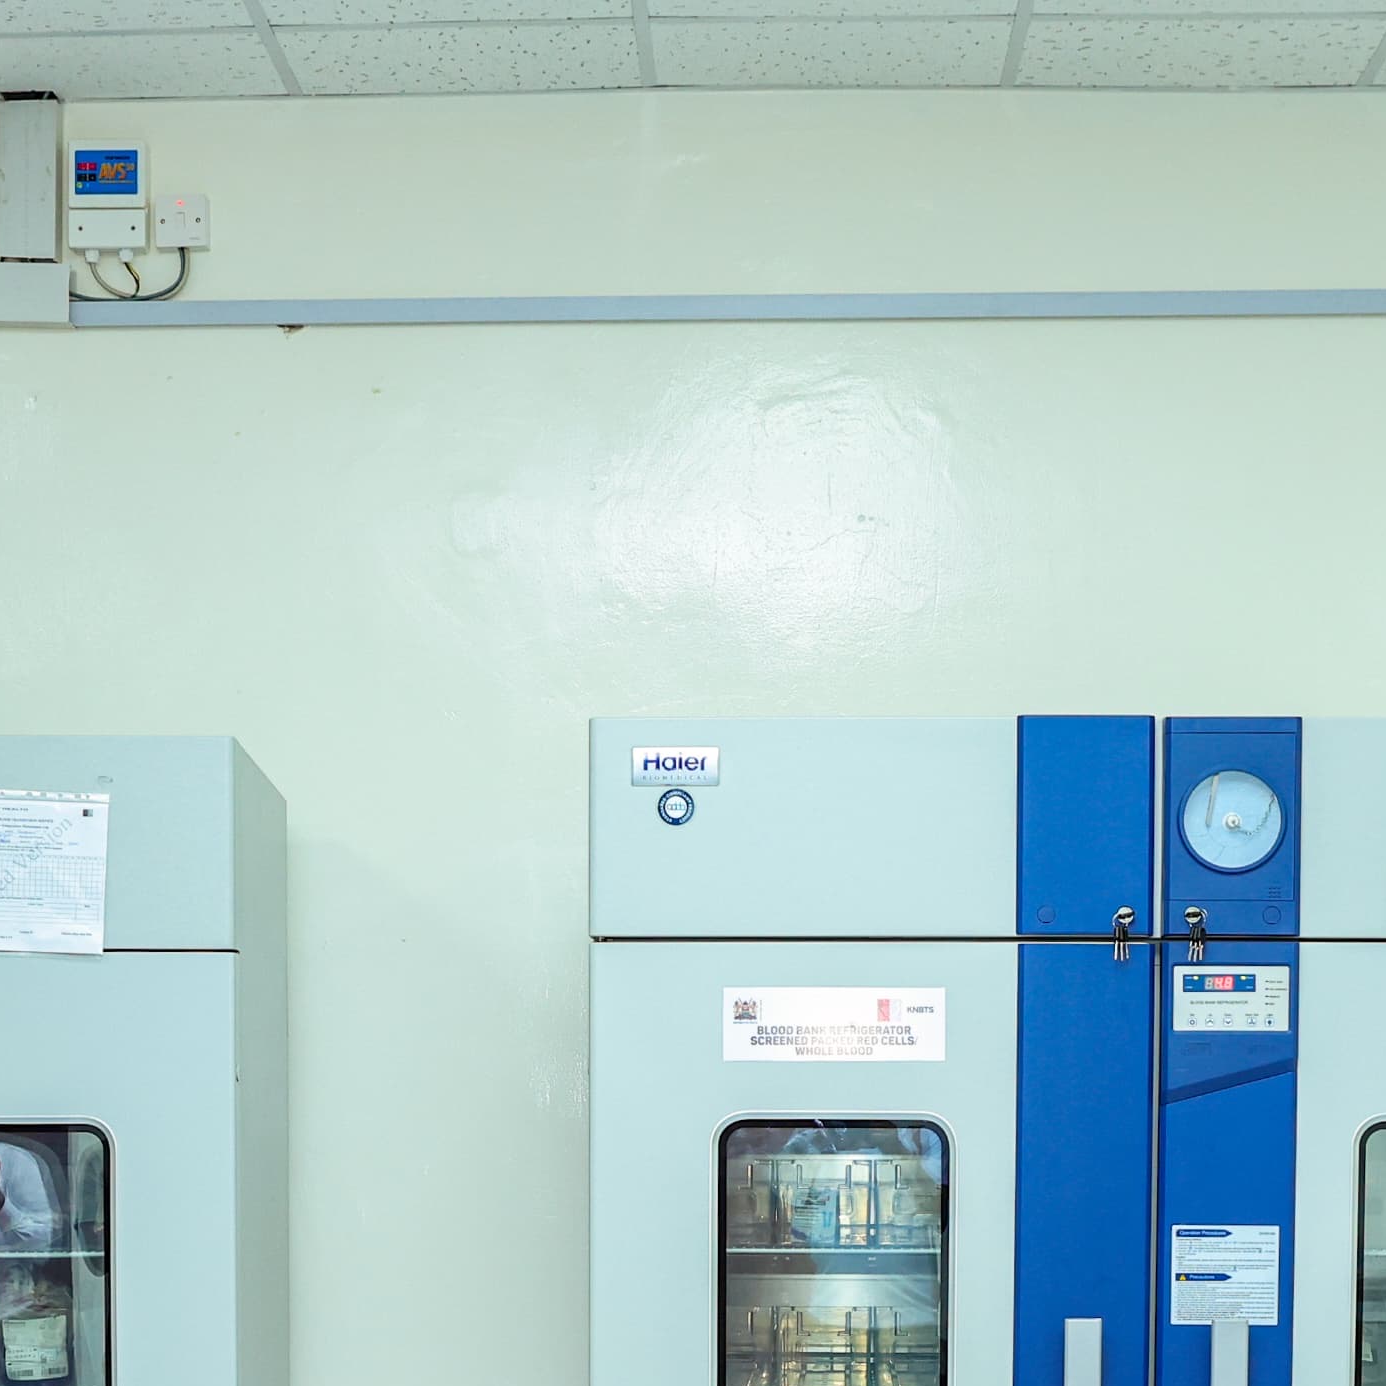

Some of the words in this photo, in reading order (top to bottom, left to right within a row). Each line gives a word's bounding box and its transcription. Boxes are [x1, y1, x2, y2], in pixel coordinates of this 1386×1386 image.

[643, 752, 708, 772] Haier
[757, 1026, 794, 1035] BLOOD
[796, 1026, 827, 1035] BANK
[829, 1025, 911, 1035] REFRIGERATOR
[750, 1036, 808, 1046] SCREENED
[811, 1036, 854, 1046] PACKED
[857, 1036, 879, 1046] RED
[881, 1036, 918, 1046] CELLS/
[795, 1046, 834, 1056] WHOLE
[837, 1046, 873, 1056] BLOOD
